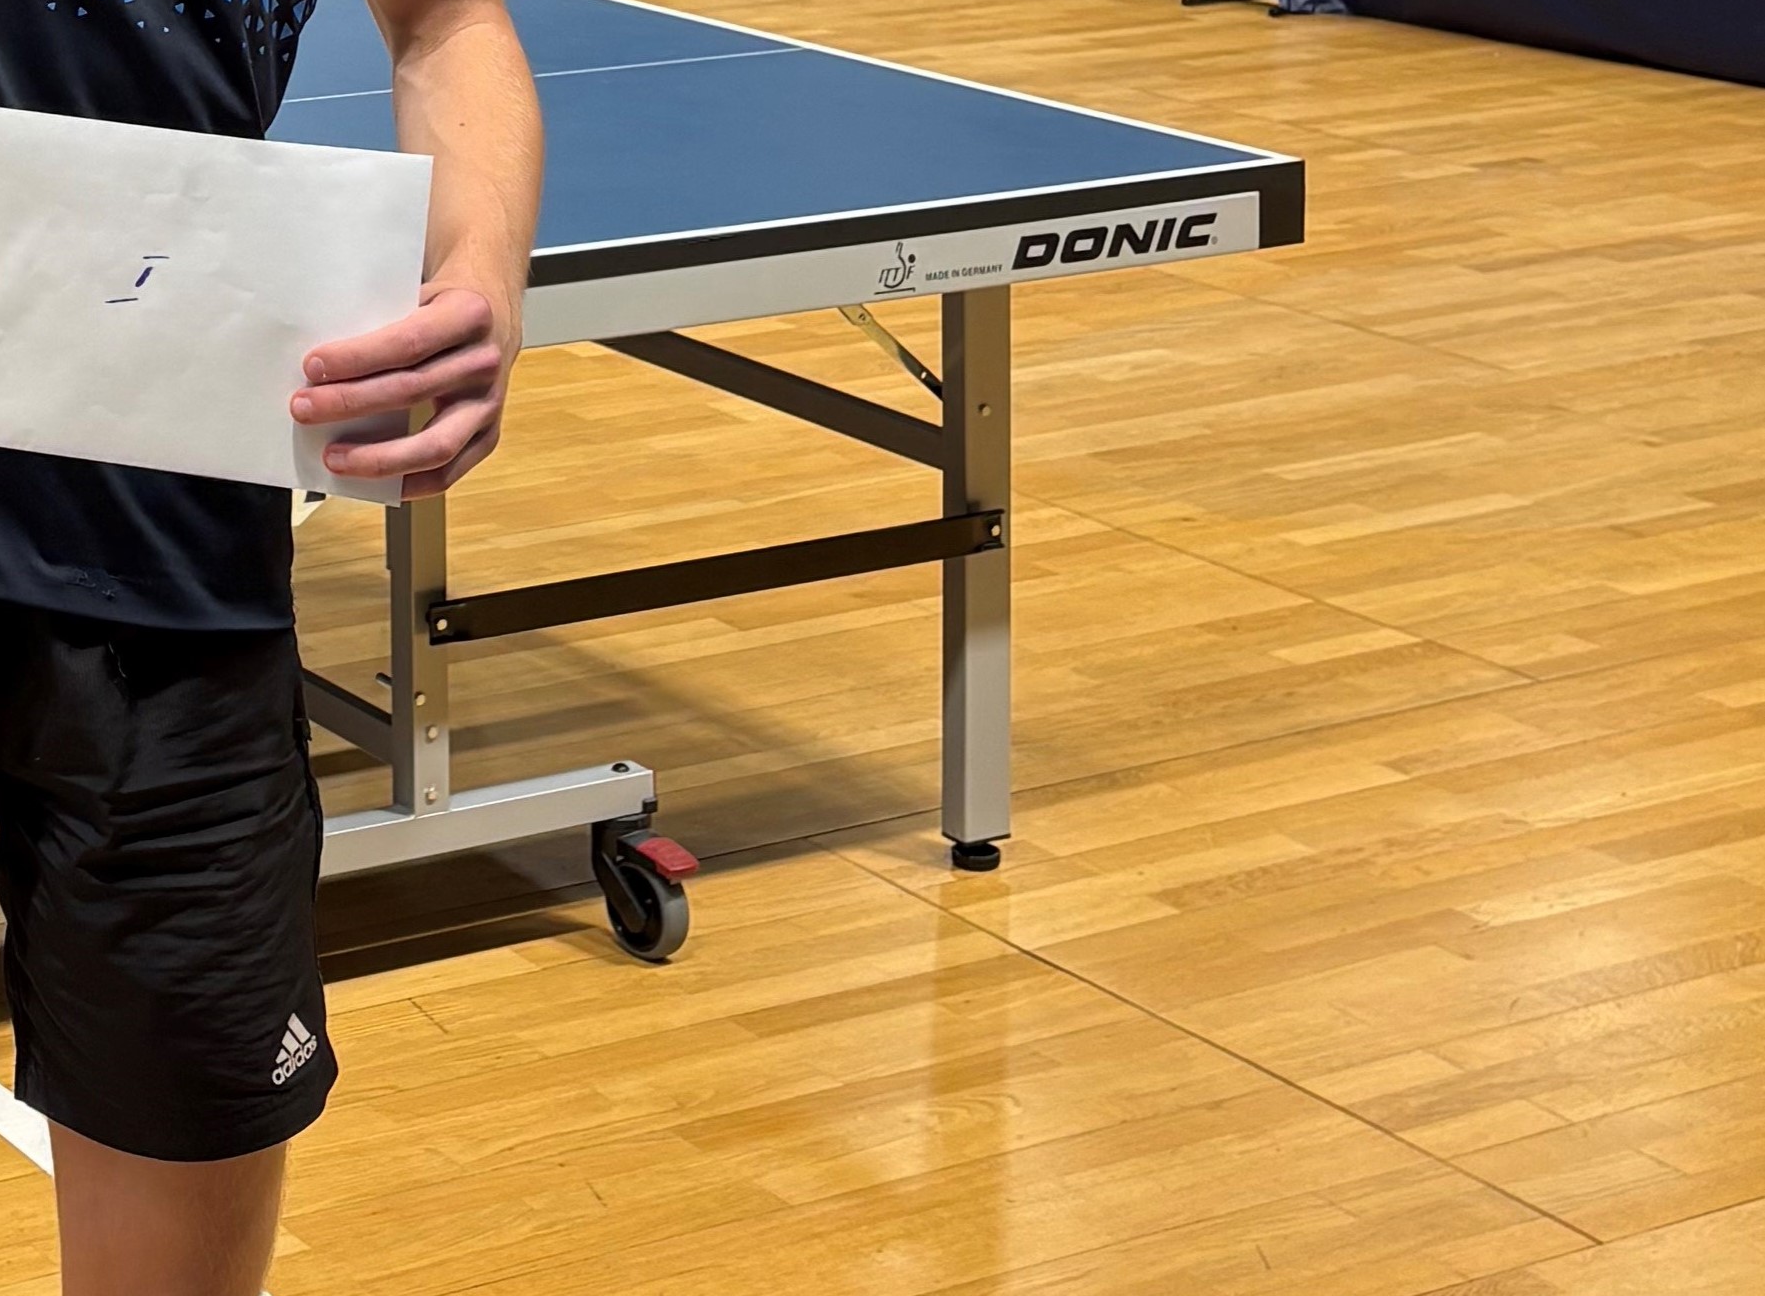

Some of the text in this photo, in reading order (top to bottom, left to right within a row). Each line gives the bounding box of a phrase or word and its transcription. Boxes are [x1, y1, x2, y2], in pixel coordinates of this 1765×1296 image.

[1011, 212, 1217, 271] DONIC
[925, 263, 1004, 282] MADE IN GERMANY
[272, 1035, 317, 1086] adidas
